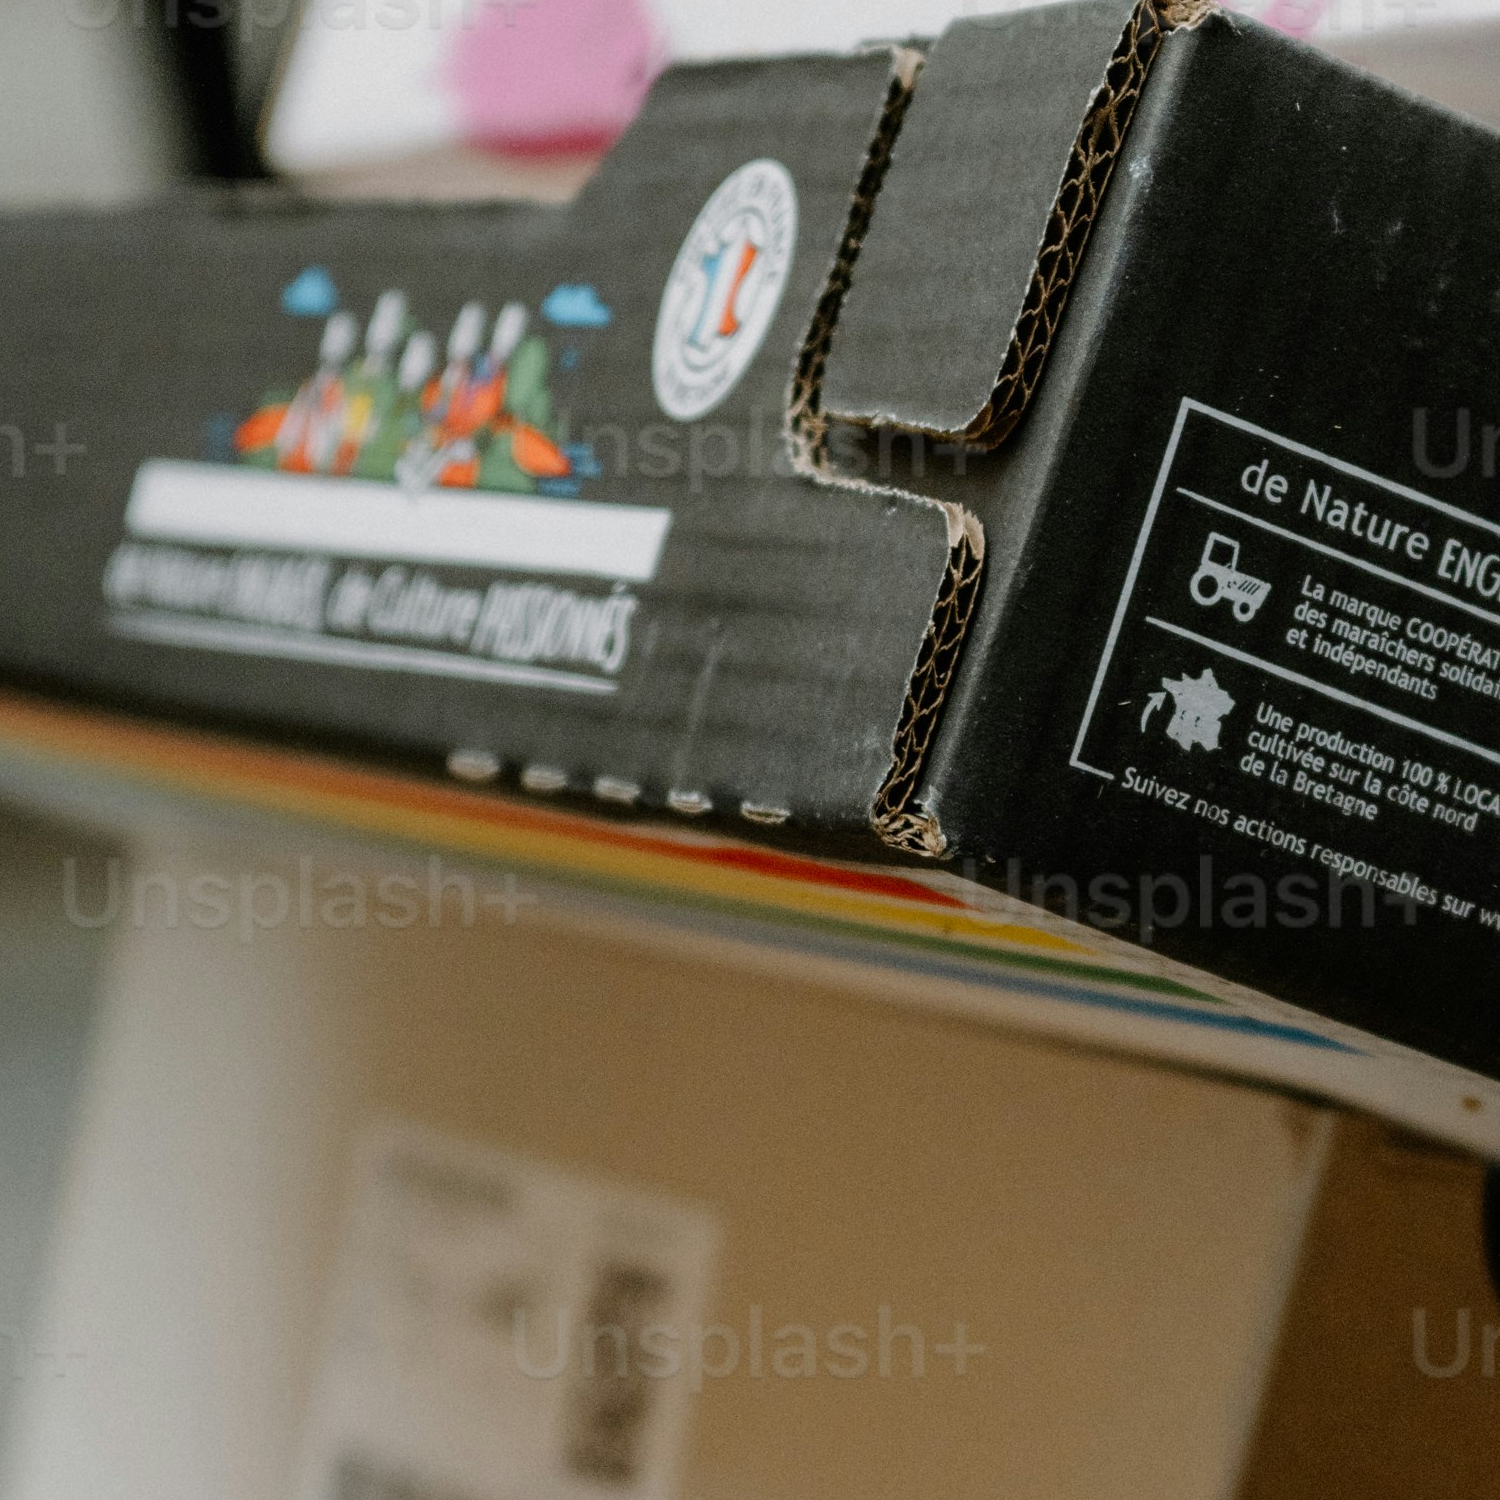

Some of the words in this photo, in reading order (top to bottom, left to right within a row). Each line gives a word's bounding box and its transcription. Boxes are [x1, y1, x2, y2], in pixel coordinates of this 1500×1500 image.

[1240, 459, 1289, 504] de
[1300, 479, 1430, 560] Nature
[366, 561, 479, 642] Culture
[1293, 600, 1328, 629] des
[1331, 618, 1436, 673] maraîchers
[1301, 574, 1325, 602] La
[1329, 590, 1402, 637] marque
[1285, 628, 1309, 650] et
[1312, 633, 1438, 700] indépendants
[1239, 752, 1266, 777] de
[1269, 760, 1289, 786] la
[1292, 770, 1379, 821] Bretagne
[1247, 730, 1326, 773] cultivée
[1328, 762, 1361, 785] sur
[1363, 770, 1382, 796] la
[1386, 783, 1430, 814] côte
[1432, 802, 1479, 832] nord
[1255, 702, 1294, 733] Une
[1294, 722, 1395, 775] production
[1401, 760, 1434, 788] 100
[1435, 772, 1451, 795] %
[1121, 767, 1191, 818] Suivez
[1194, 798, 1231, 828] nos
[1232, 809, 1308, 858] actions
[1309, 836, 1441, 906] responsables
[1442, 888, 1478, 920] sur
